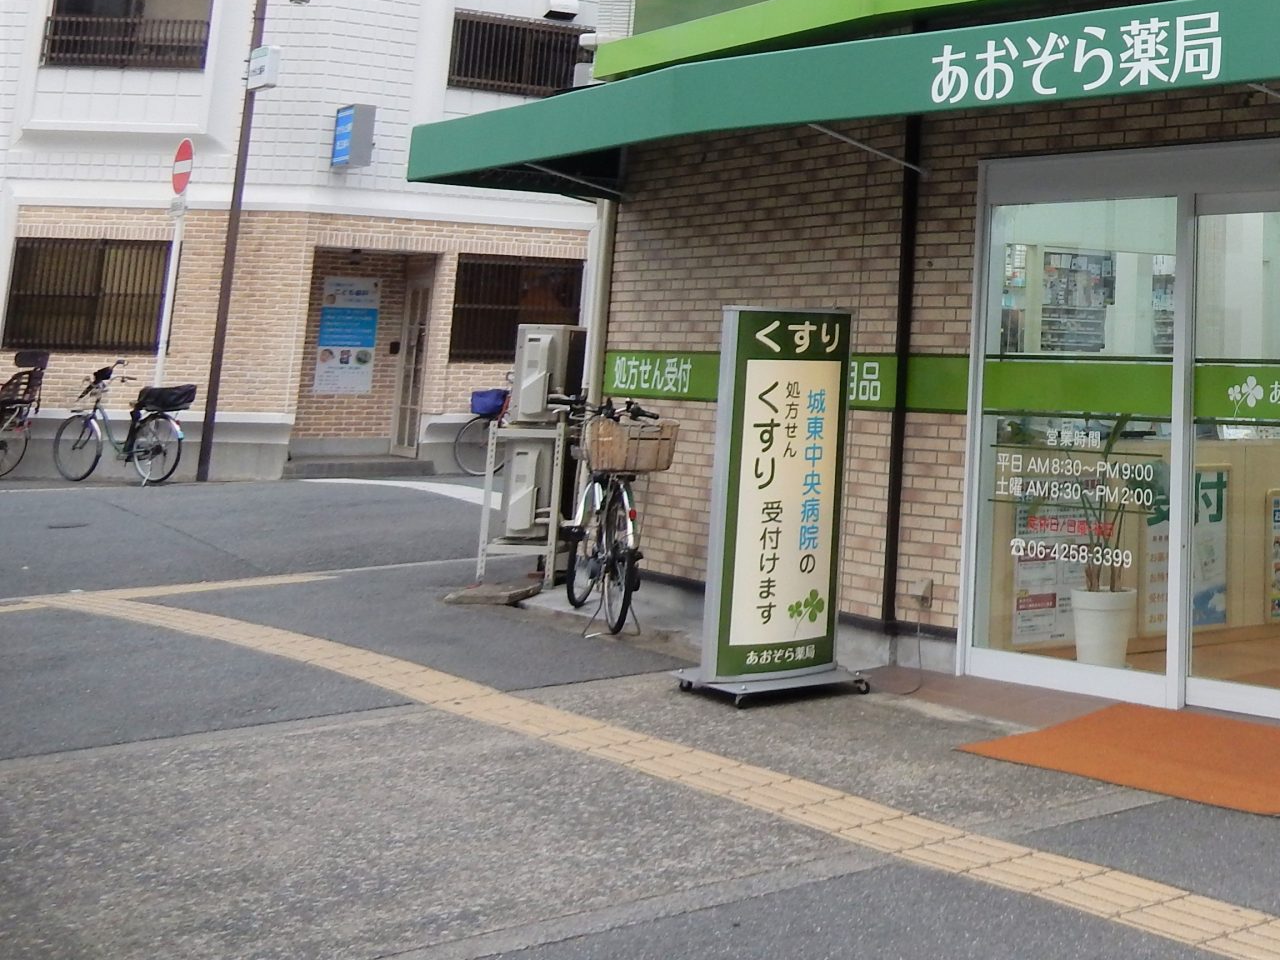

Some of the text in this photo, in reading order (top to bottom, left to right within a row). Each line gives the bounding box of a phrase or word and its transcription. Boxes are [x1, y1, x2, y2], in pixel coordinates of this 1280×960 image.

[931, 11, 1222, 104] あおぞら薬局
[755, 320, 840, 353] くすり
[613, 356, 692, 393] 処方せん受付
[783, 381, 801, 458] 処方せん
[1047, 429, 1101, 449] 営業時間
[997, 453, 1023, 473] 平日
[799, 389, 826, 574] 城東中央病院の
[995, 476, 1023, 497] 土曜
[753, 381, 783, 625] くすり 受付けます
[1027, 541, 1132, 568] 06-4258-3399
[745, 644, 816, 665] あおぞら薬局
